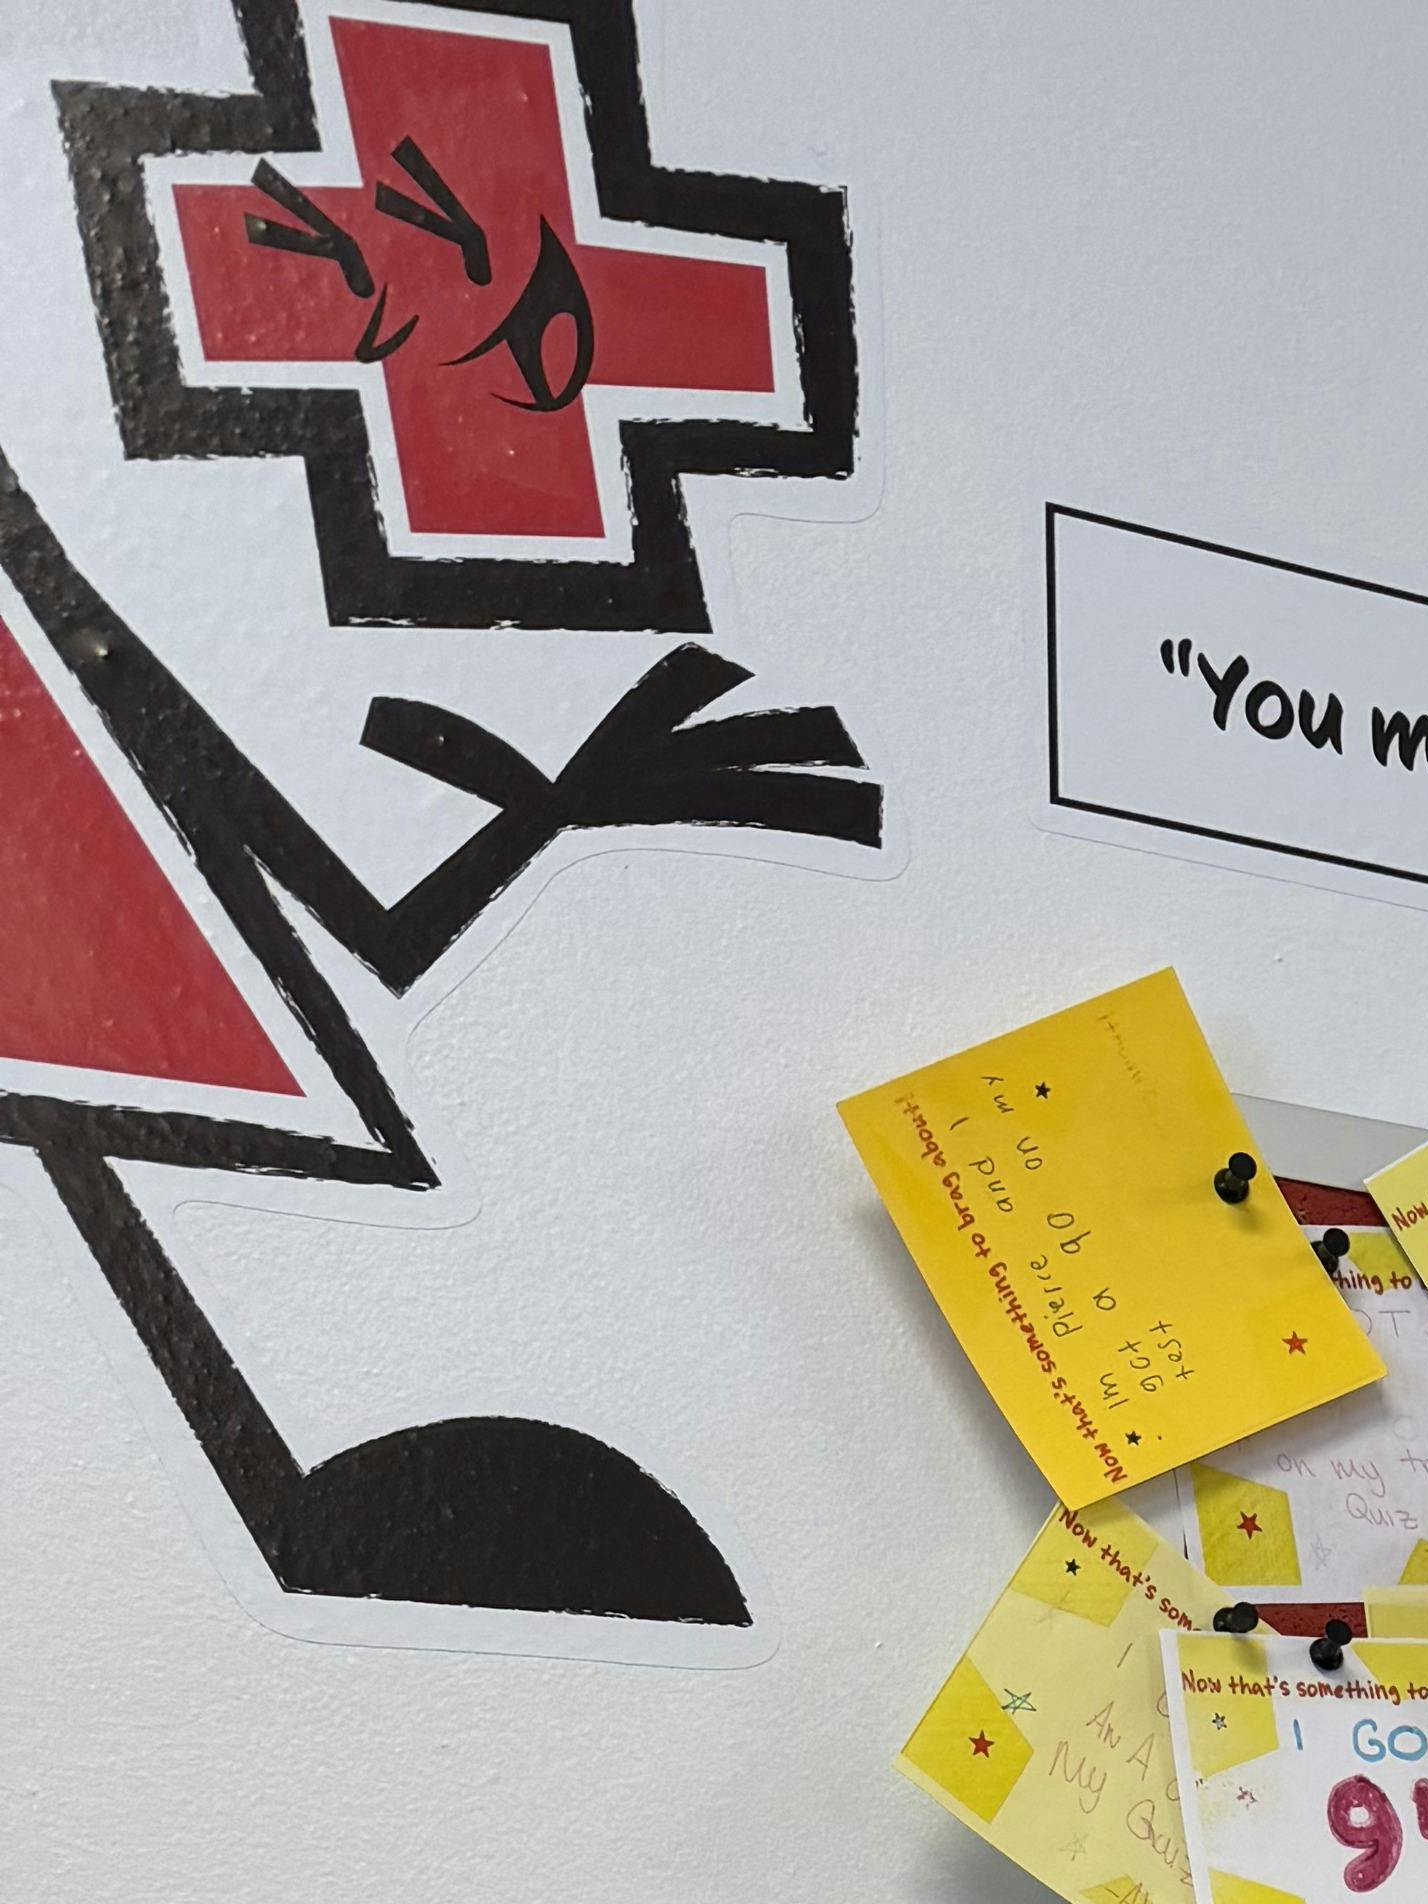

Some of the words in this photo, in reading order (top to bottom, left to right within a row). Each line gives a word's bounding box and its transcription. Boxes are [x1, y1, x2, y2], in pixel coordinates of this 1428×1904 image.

[941, 1171, 976, 1234] brag
[1392, 1199, 1427, 1231] Now
[972, 1229, 993, 1259] to
[988, 1262, 1059, 1376] something
[1053, 1374, 1099, 1440] that's
[1098, 1442, 1127, 1484] Now
[1293, 1719, 1304, 1752] I
